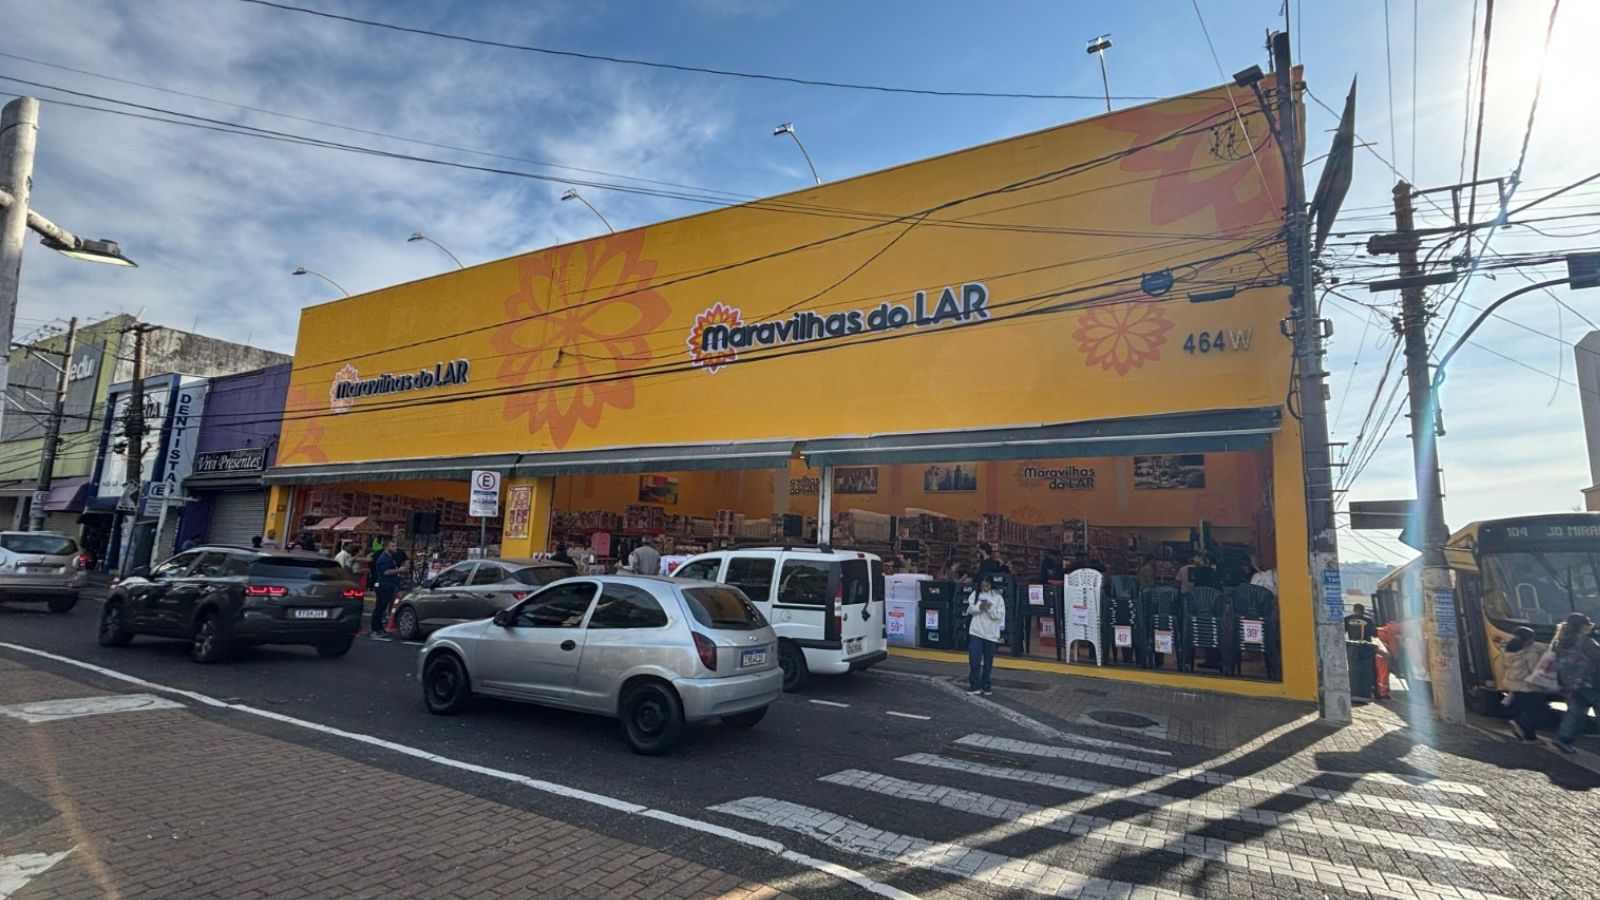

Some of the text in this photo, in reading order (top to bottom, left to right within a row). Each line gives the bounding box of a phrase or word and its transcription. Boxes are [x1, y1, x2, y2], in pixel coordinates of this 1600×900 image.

[868, 303, 909, 331] do
[915, 284, 987, 325] LAR
[414, 370, 434, 389] do
[434, 360, 469, 387] LAR
[166, 394, 192, 482] DENTISTA
[220, 454, 263, 470] Presentes
[482, 475, 490, 487] E
[1049, 478, 1066, 490] do
[1070, 478, 1094, 489] LAR
